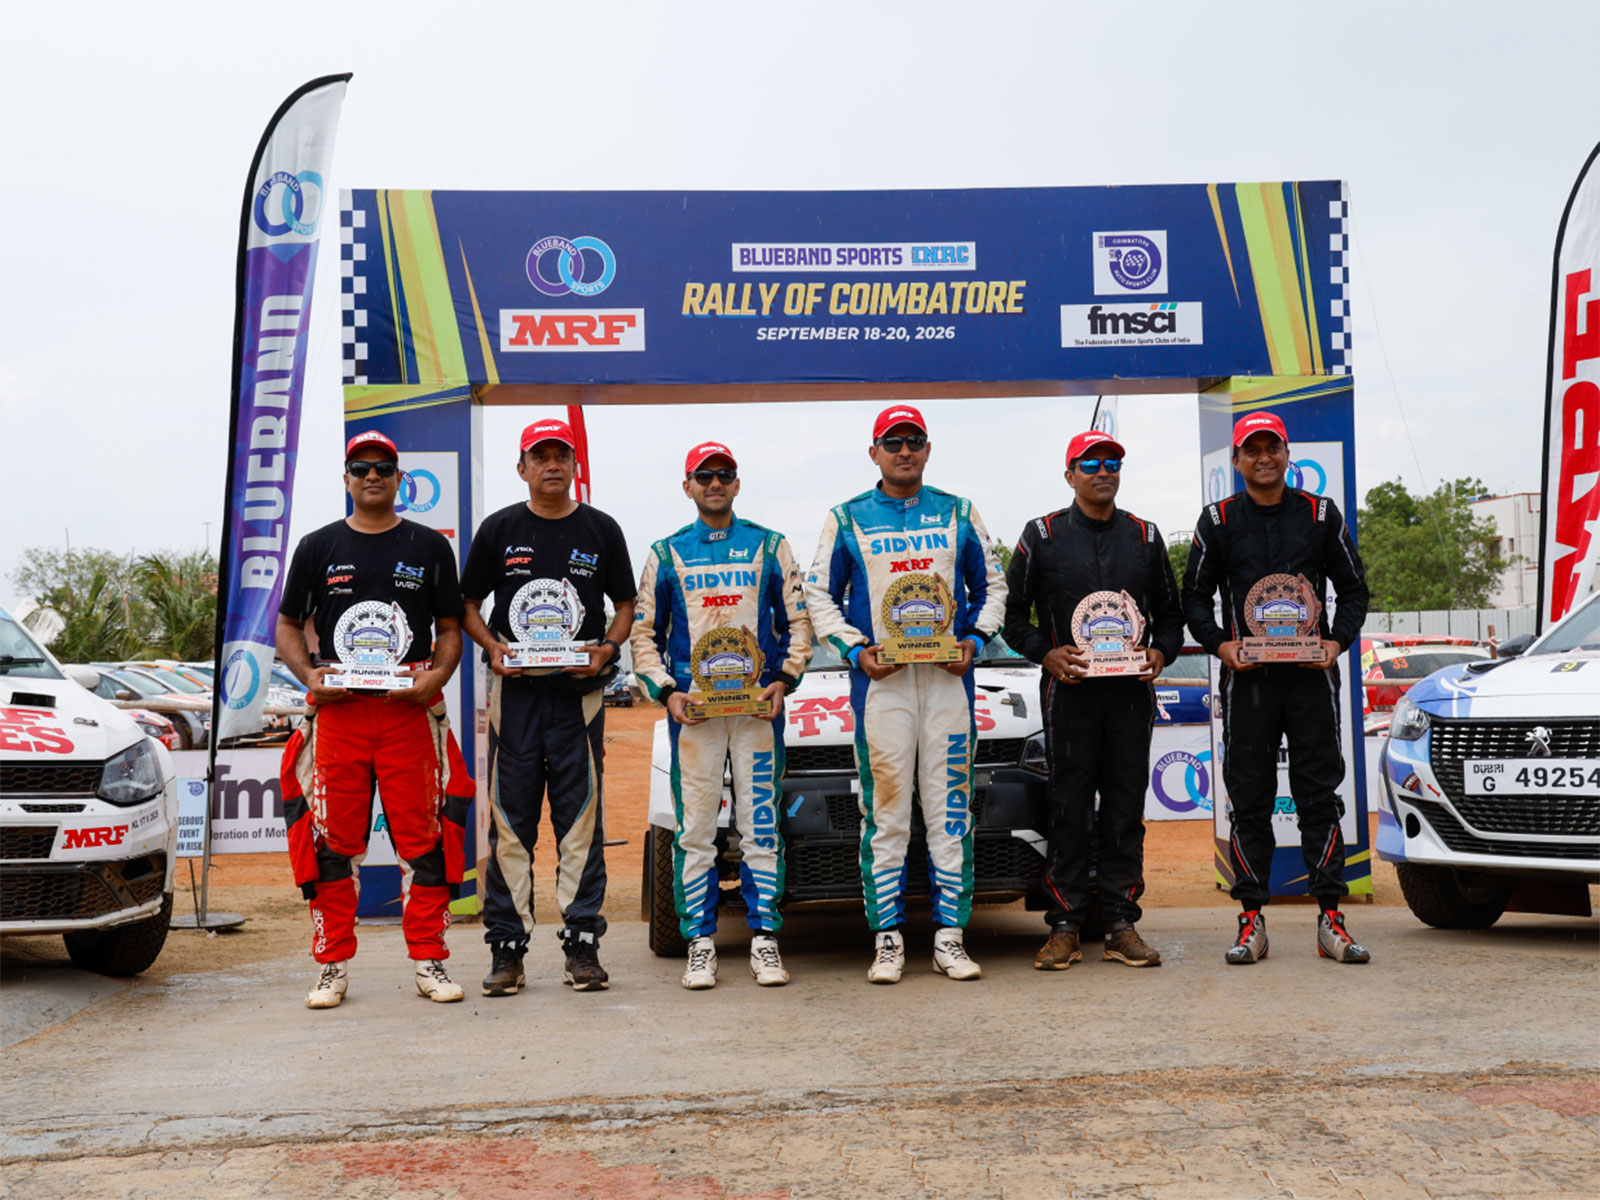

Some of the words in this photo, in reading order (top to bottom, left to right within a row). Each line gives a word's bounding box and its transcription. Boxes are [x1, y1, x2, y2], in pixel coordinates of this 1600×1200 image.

[532, 239, 577, 257] BLUEBAND
[739, 247, 832, 266] BLUEBAND
[836, 247, 903, 265] SPORTS
[571, 281, 605, 294] SPORTS
[682, 282, 780, 316] RALLY
[783, 282, 826, 316] OF
[829, 280, 1027, 316] COIMBATORE
[1088, 303, 1177, 335] fmsci
[508, 314, 636, 346] MRF
[756, 327, 859, 341] SEPTEMBER
[863, 327, 910, 342] 18-20,
[915, 326, 956, 340] 2026
[1137, 337, 1154, 345] Sports
[240, 294, 304, 590] BLUEBAND
[871, 532, 948, 555] SIDVIN
[890, 558, 934, 573] MRF
[684, 571, 757, 591] SIDVIN
[702, 595, 743, 607] MRF
[897, 641, 941, 649] WINNER
[1390, 657, 1409, 670] 33
[707, 694, 750, 702] WINNER
[1156, 753, 1202, 773] BLUEBAND
[945, 733, 967, 838] SIDVIN
[1482, 776, 1496, 792] G
[1515, 766, 1600, 789] 49254
[752, 751, 776, 850] SIDVIN
[61, 824, 129, 849] MRF
[179, 829, 200, 839] EVENT
[212, 829, 249, 841] eration
[252, 828, 262, 839] of
[265, 827, 286, 839] Mot
